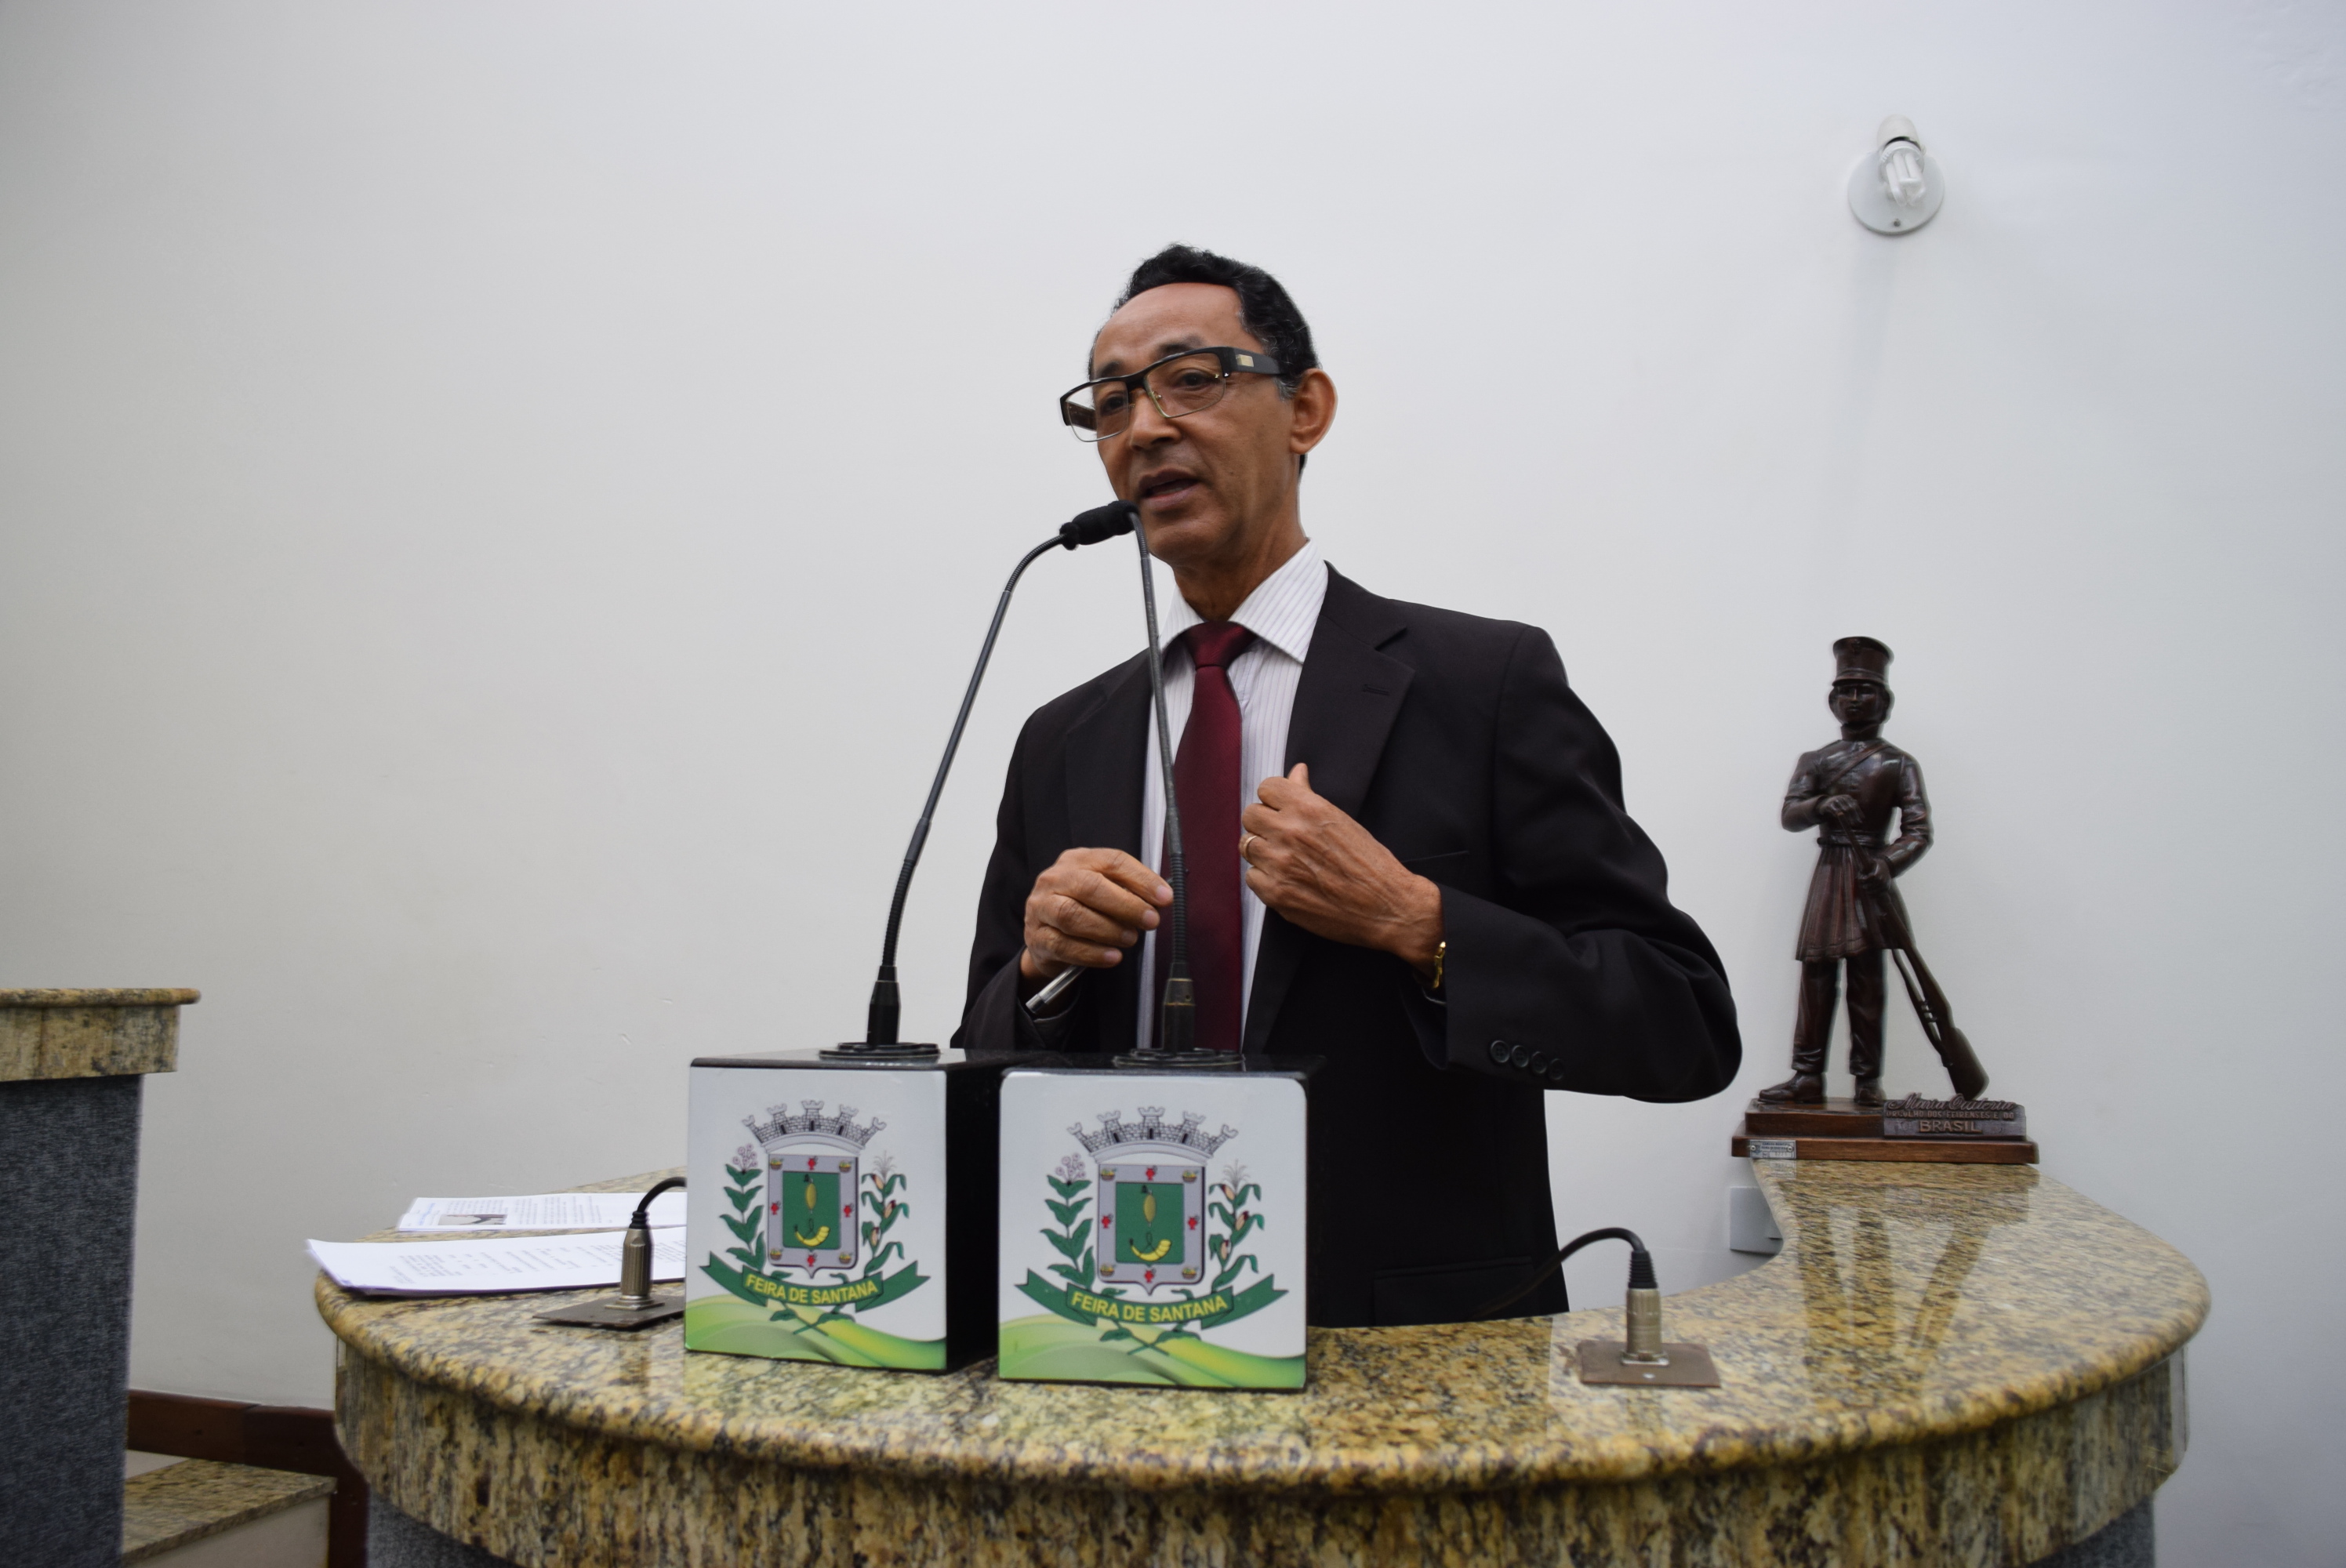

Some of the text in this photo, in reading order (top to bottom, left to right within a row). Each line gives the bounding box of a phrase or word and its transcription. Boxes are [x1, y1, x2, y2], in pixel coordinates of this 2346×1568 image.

[1919, 1120, 1983, 1132] BRASIL
[746, 1274, 878, 1305] FEIRA DE SANTANA
[1071, 1291, 1228, 1323] FEIRA DE SANTANA
